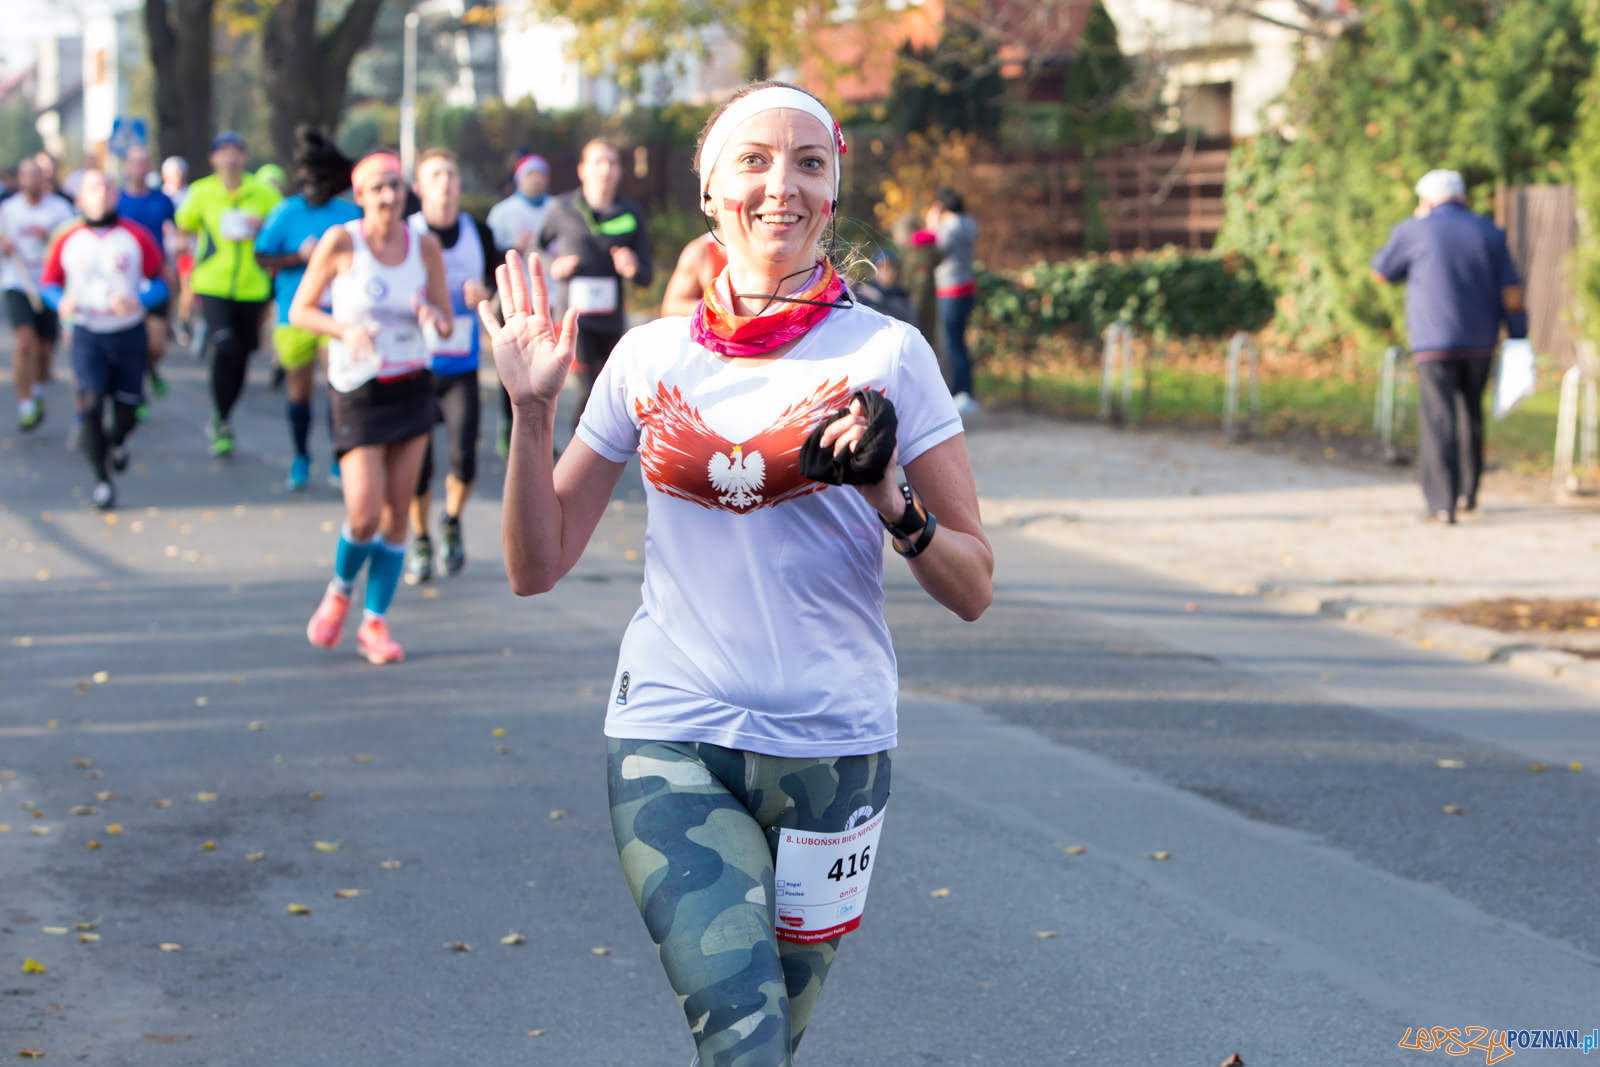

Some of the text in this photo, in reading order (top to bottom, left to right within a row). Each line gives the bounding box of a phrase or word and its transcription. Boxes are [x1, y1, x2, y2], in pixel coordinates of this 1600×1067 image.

[786, 835, 794, 843] 8.
[796, 836, 841, 846] LUBOŃSKI
[841, 833, 857, 845] BIEG
[827, 845, 871, 882] 416
[839, 886, 858, 899] anita
